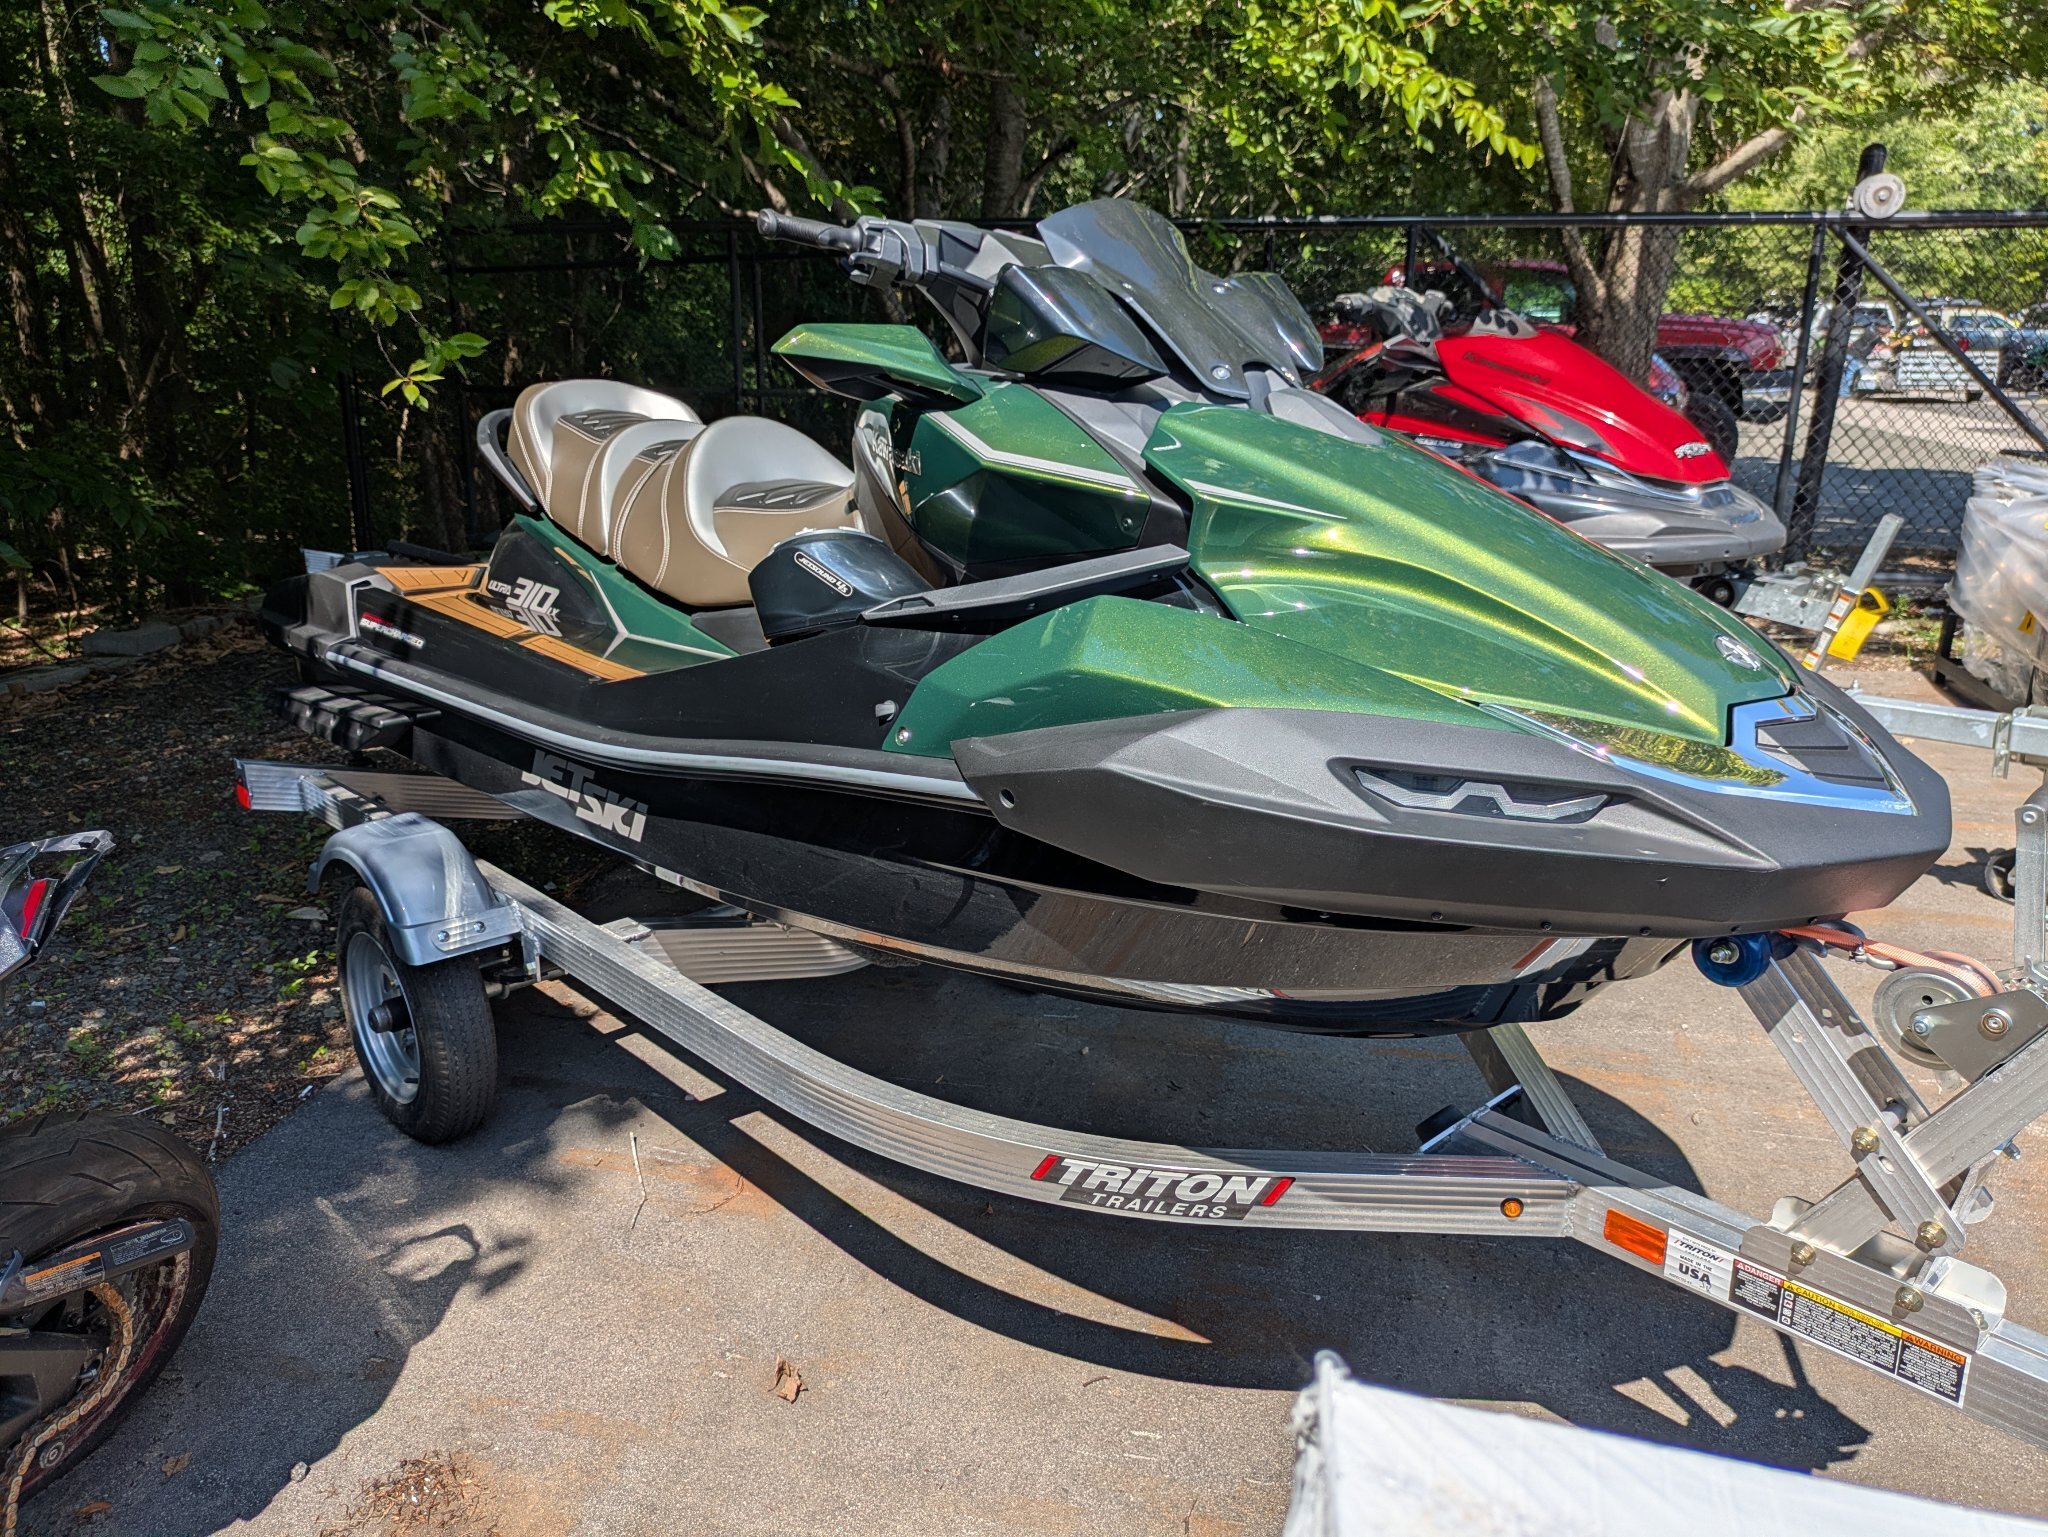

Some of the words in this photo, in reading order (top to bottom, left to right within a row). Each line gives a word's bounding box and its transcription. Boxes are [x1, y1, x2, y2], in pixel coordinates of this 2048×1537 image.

[487, 580, 512, 595] ULTRA
[505, 577, 560, 614] 310
[521, 749, 595, 803] JET
[576, 782, 649, 843] SKI
[1058, 1158, 1271, 1205] TRITON
[1090, 1192, 1228, 1219] TRAILERS
[1680, 1241, 1719, 1260] TRITON
[1680, 1255, 1693, 1264] MADE
[1679, 1262, 1711, 1285] USA
[1744, 1266, 1781, 1286] DANGER
[1796, 1287, 1836, 1309] CAUTION
[1913, 1338, 1962, 1362] WARNING
